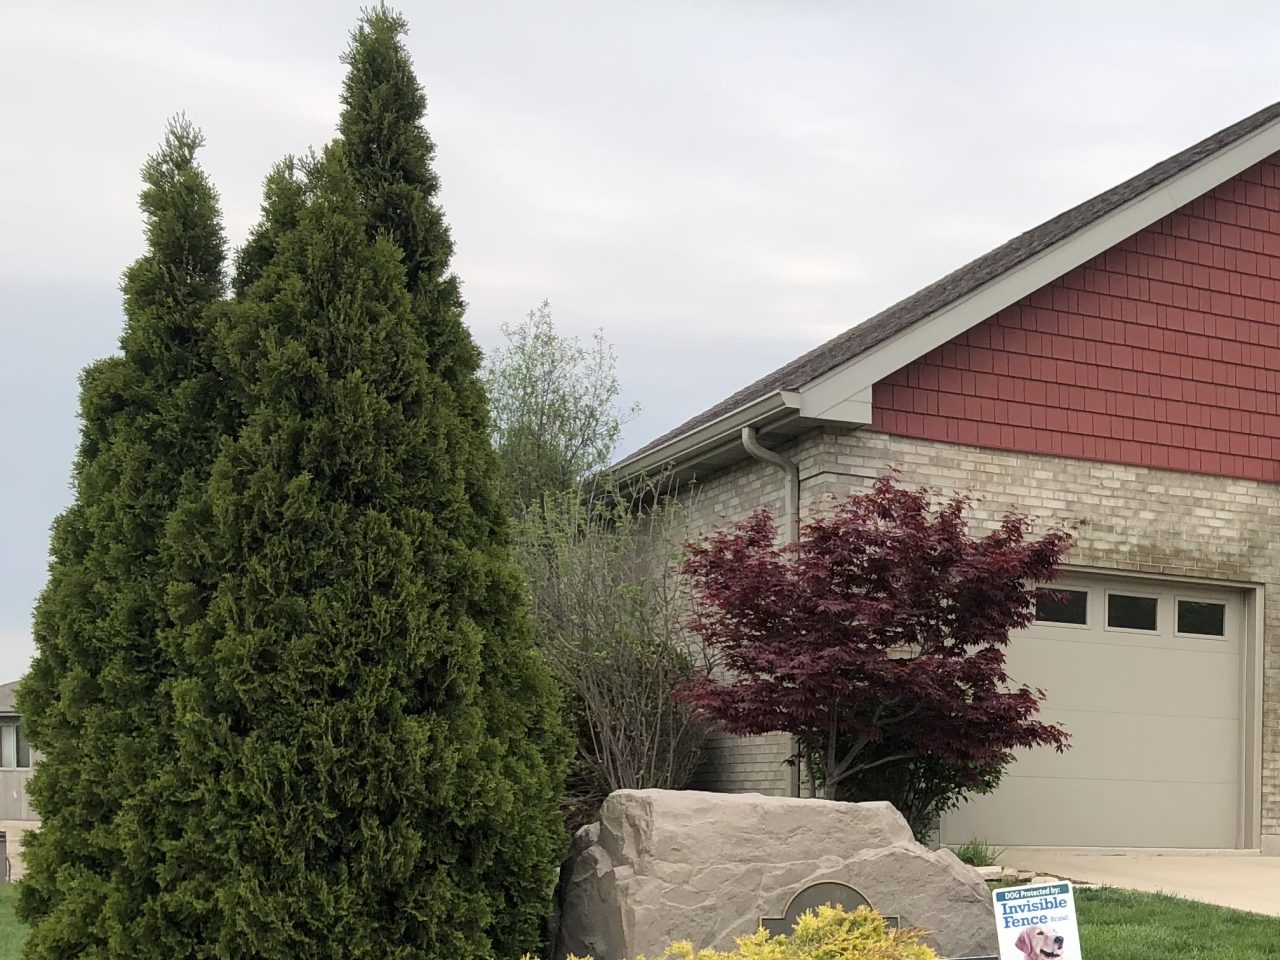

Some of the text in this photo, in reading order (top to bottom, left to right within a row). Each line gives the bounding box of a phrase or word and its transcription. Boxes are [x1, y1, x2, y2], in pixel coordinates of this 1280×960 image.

[1004, 886, 1061, 900] DOG Protected by:
[1000, 896, 1068, 916] Invisible
[1002, 914, 1048, 929] Fence
